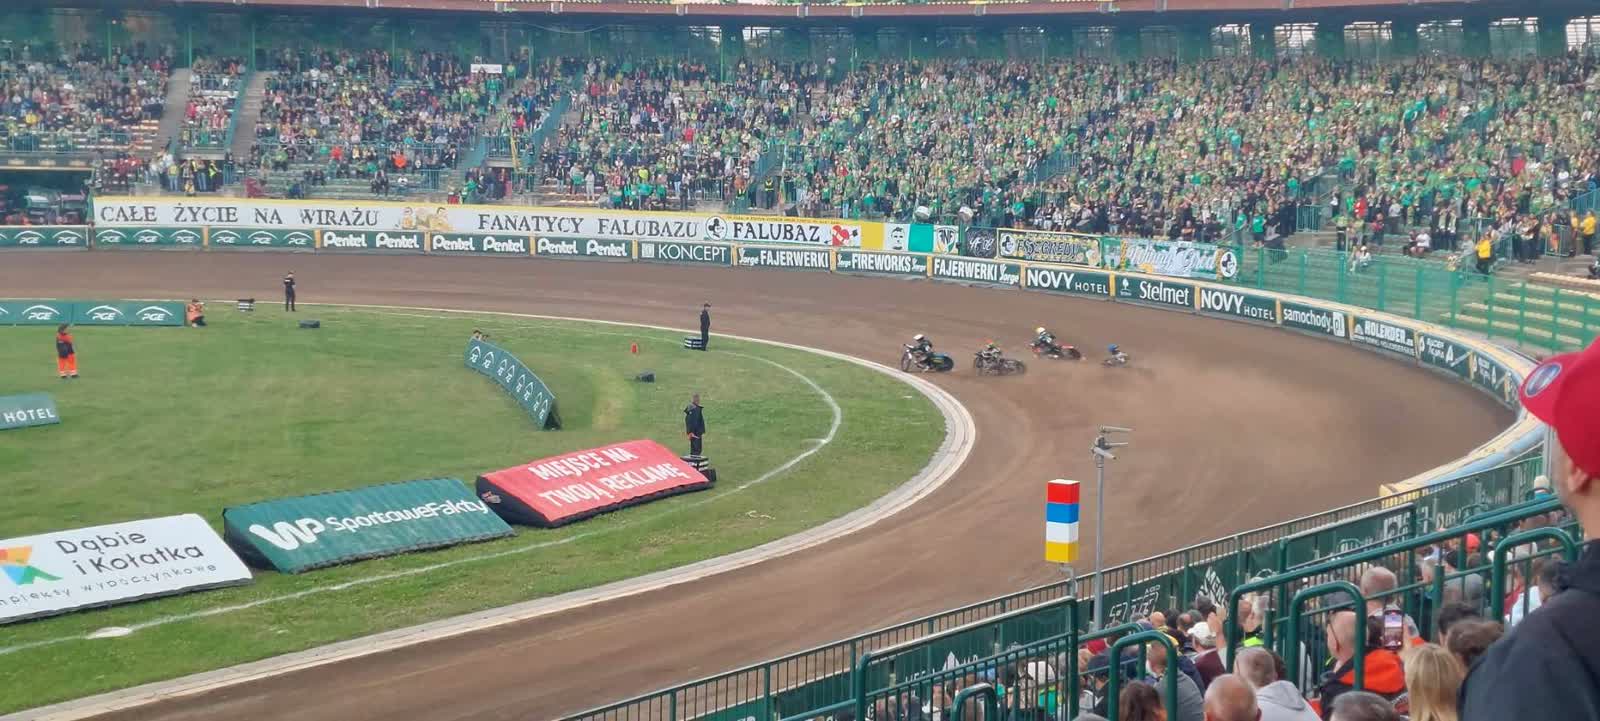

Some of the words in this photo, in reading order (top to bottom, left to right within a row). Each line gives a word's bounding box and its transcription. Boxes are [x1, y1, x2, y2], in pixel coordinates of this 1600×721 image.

[100, 205, 158, 222] CAŁE
[174, 202, 238, 223] ŻYCIE
[255, 208, 283, 224] NA
[301, 207, 379, 226] WIRAŻU
[478, 213, 584, 234] FANATYCY
[598, 218, 698, 238] FALUBAZU
[733, 221, 820, 243] FALUBAZ
[323, 231, 367, 248] Pentel
[375, 232, 420, 249] Pentel
[432, 234, 475, 251] Pentel
[483, 236, 525, 252] Pentel
[537, 238, 578, 255] Pentel
[586, 239, 627, 257] Pentel
[658, 243, 727, 262] KONCEPT
[760, 250, 829, 268] FAJERWERKI
[851, 253, 911, 272] FIREWORKS
[934, 257, 998, 281] FAJERWERKI
[1027, 269, 1074, 290] NOVY
[1075, 282, 1108, 294] HOTEL
[1139, 281, 1190, 306] Stelmet
[1201, 289, 1244, 314] NOVY
[1244, 306, 1275, 320] HOTEL
[28, 312, 53, 320] PGE
[92, 312, 116, 321] PGE
[142, 313, 166, 321] PGE
[3, 408, 56, 423] HOTEL
[528, 451, 606, 480] MIEJSCE
[605, 447, 639, 464] NA
[538, 481, 610, 507] TWOJĄ
[602, 462, 691, 493] REKLAMĘ
[249, 517, 326, 550] WP
[325, 500, 488, 533] SportoweFakty
[56, 531, 147, 554] Dąbie
[72, 559, 87, 575] i
[90, 543, 204, 573] Kołatka
[81, 563, 217, 592] wypoczynkowe
